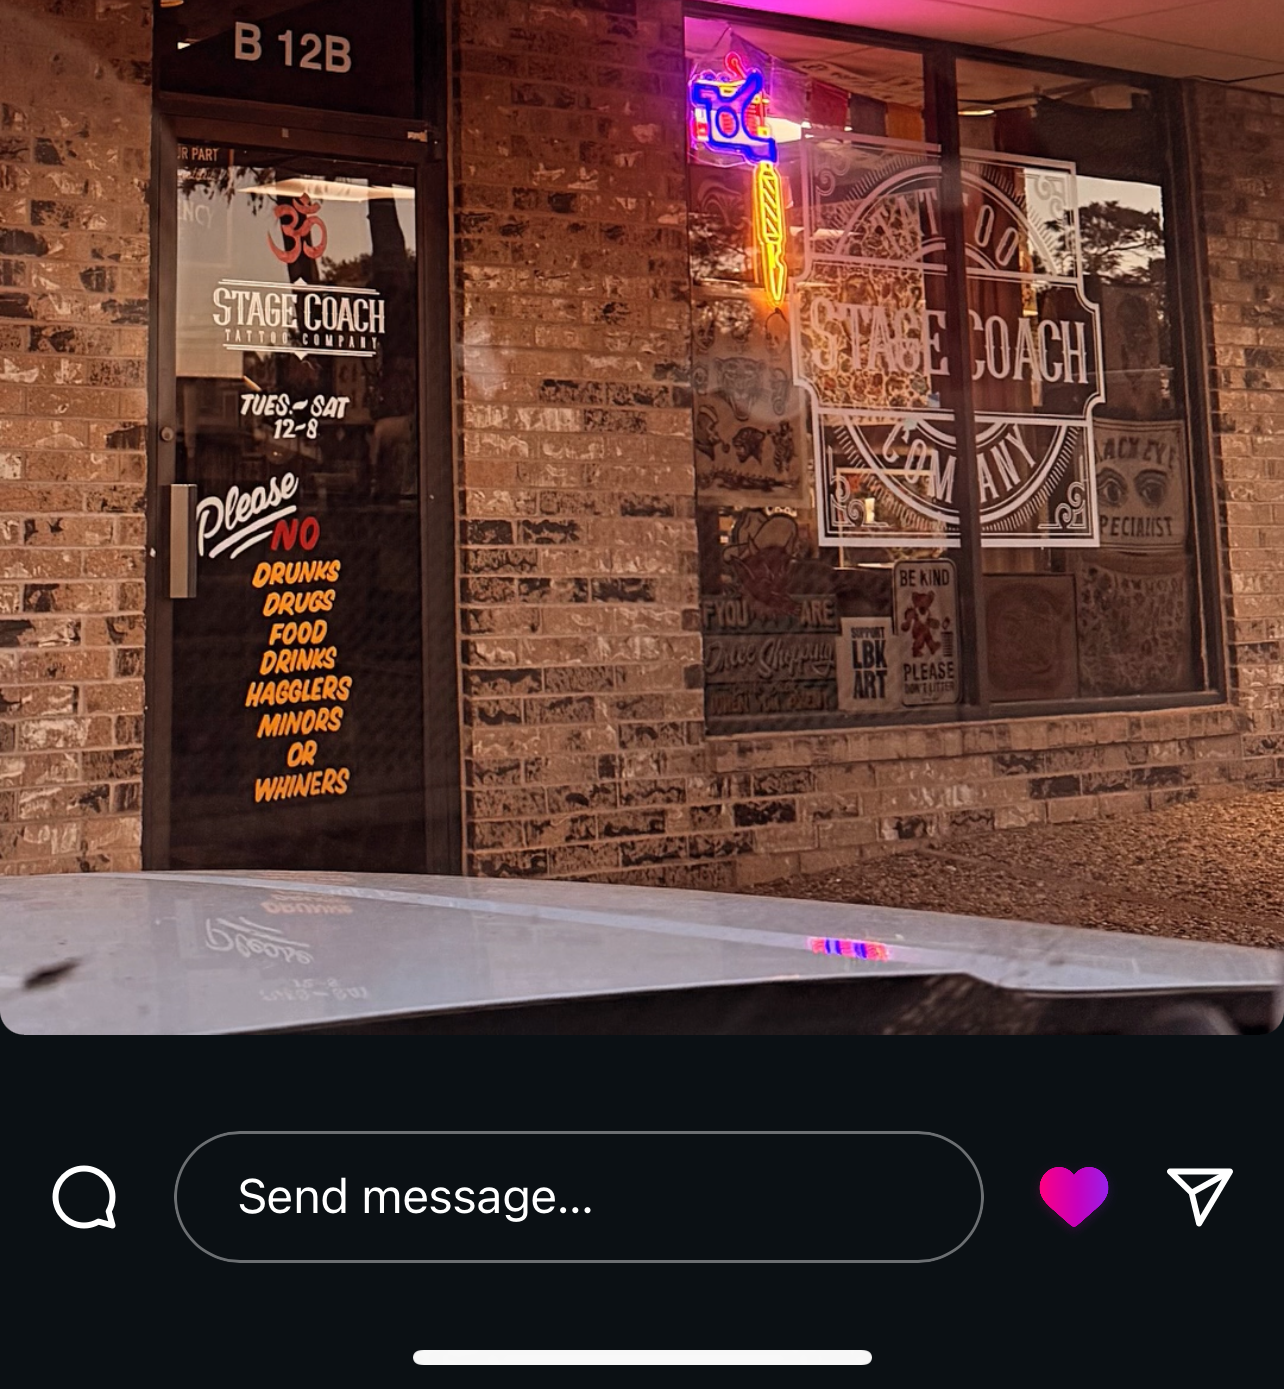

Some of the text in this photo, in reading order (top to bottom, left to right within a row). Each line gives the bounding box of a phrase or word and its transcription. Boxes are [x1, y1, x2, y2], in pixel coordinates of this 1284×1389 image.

[234, 21, 352, 74] B 12B
[191, 147, 219, 161] PART
[869, 187, 1019, 267] TATOO
[213, 287, 386, 334] STAGE COACH
[224, 328, 379, 350] TATTOO COMPANY
[809, 297, 1089, 385] STAGE COACH
[311, 395, 350, 419] SAT
[273, 418, 319, 439] 12-8
[882, 422, 1036, 504] COMANY
[195, 471, 299, 558] Please
[1099, 514, 1173, 537] PECIALIST
[270, 516, 321, 552] NO
[251, 559, 341, 589] DRUNKS
[900, 569, 950, 587] BE KIND
[262, 589, 336, 617] DRUGS
[268, 619, 328, 646] FOOD
[259, 646, 337, 676] DRINKS
[851, 639, 888, 669] LBK
[853, 670, 888, 700] ART
[903, 662, 955, 682] PLEASE
[245, 675, 353, 708] HAGGLERS
[256, 706, 344, 739] MINORS
[286, 739, 318, 768] OR
[254, 767, 350, 803] WHINERS
